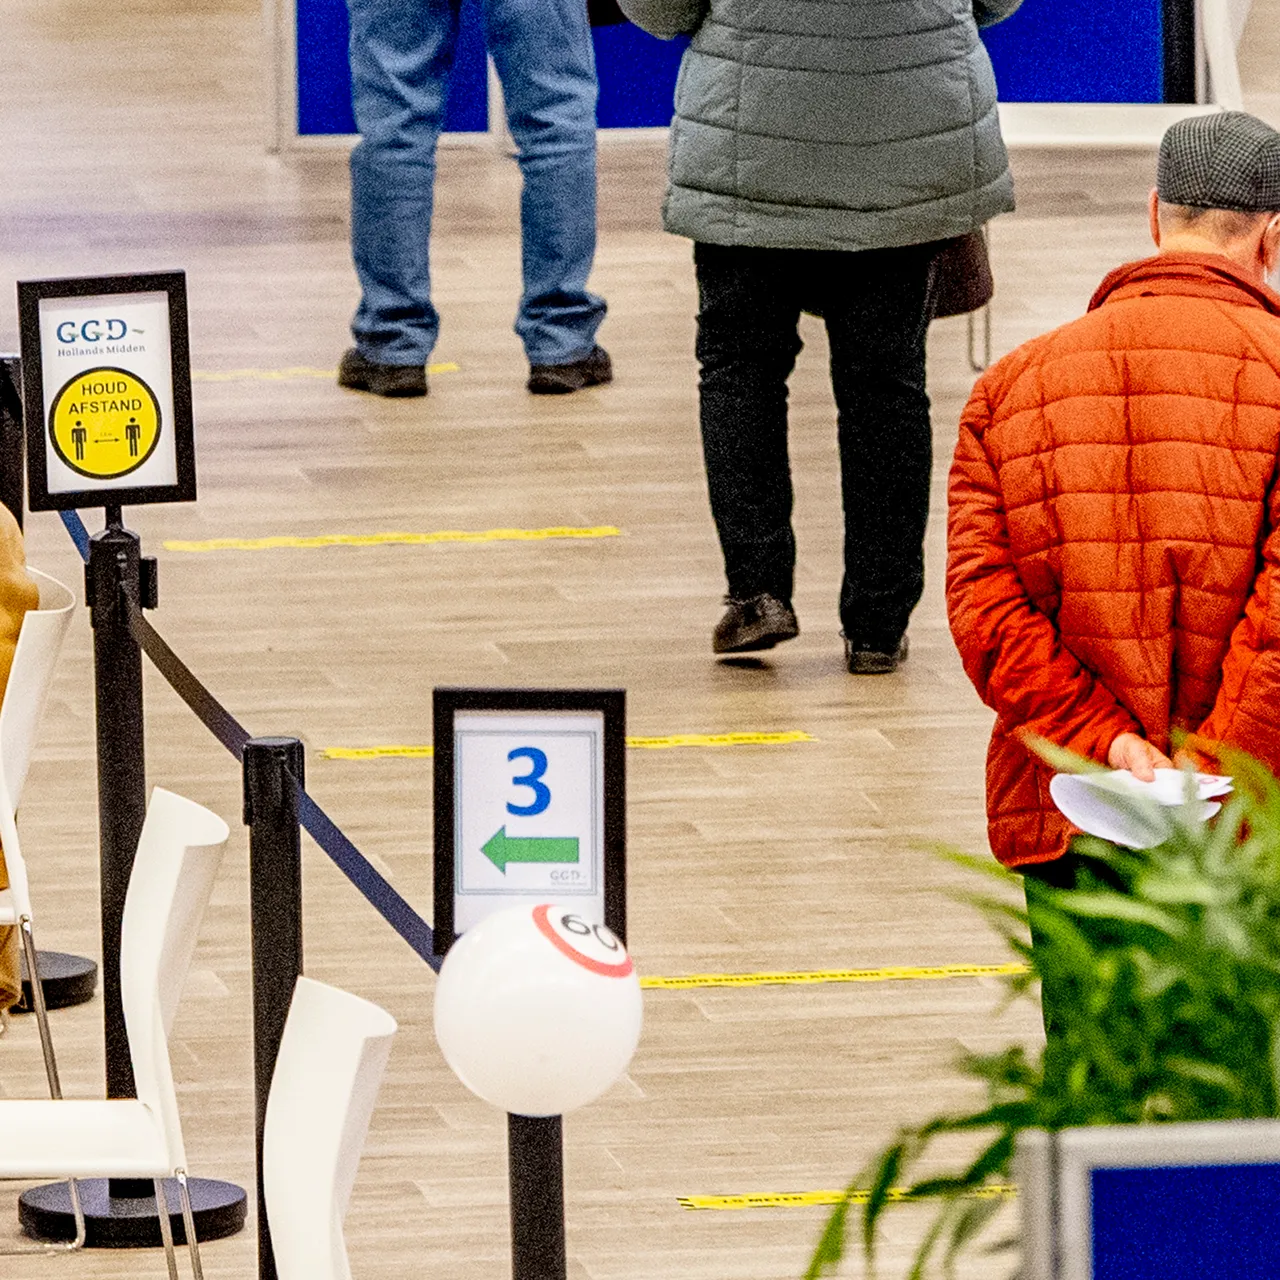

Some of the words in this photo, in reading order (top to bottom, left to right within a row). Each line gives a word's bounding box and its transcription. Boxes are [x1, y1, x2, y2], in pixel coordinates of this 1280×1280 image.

[57, 319, 127, 343] GGD
[57, 346, 104, 357] Hollands
[106, 344, 146, 355] Midden
[82, 381, 127, 396] HOUD
[69, 399, 142, 415] AFSTAND
[506, 747, 551, 817] 3
